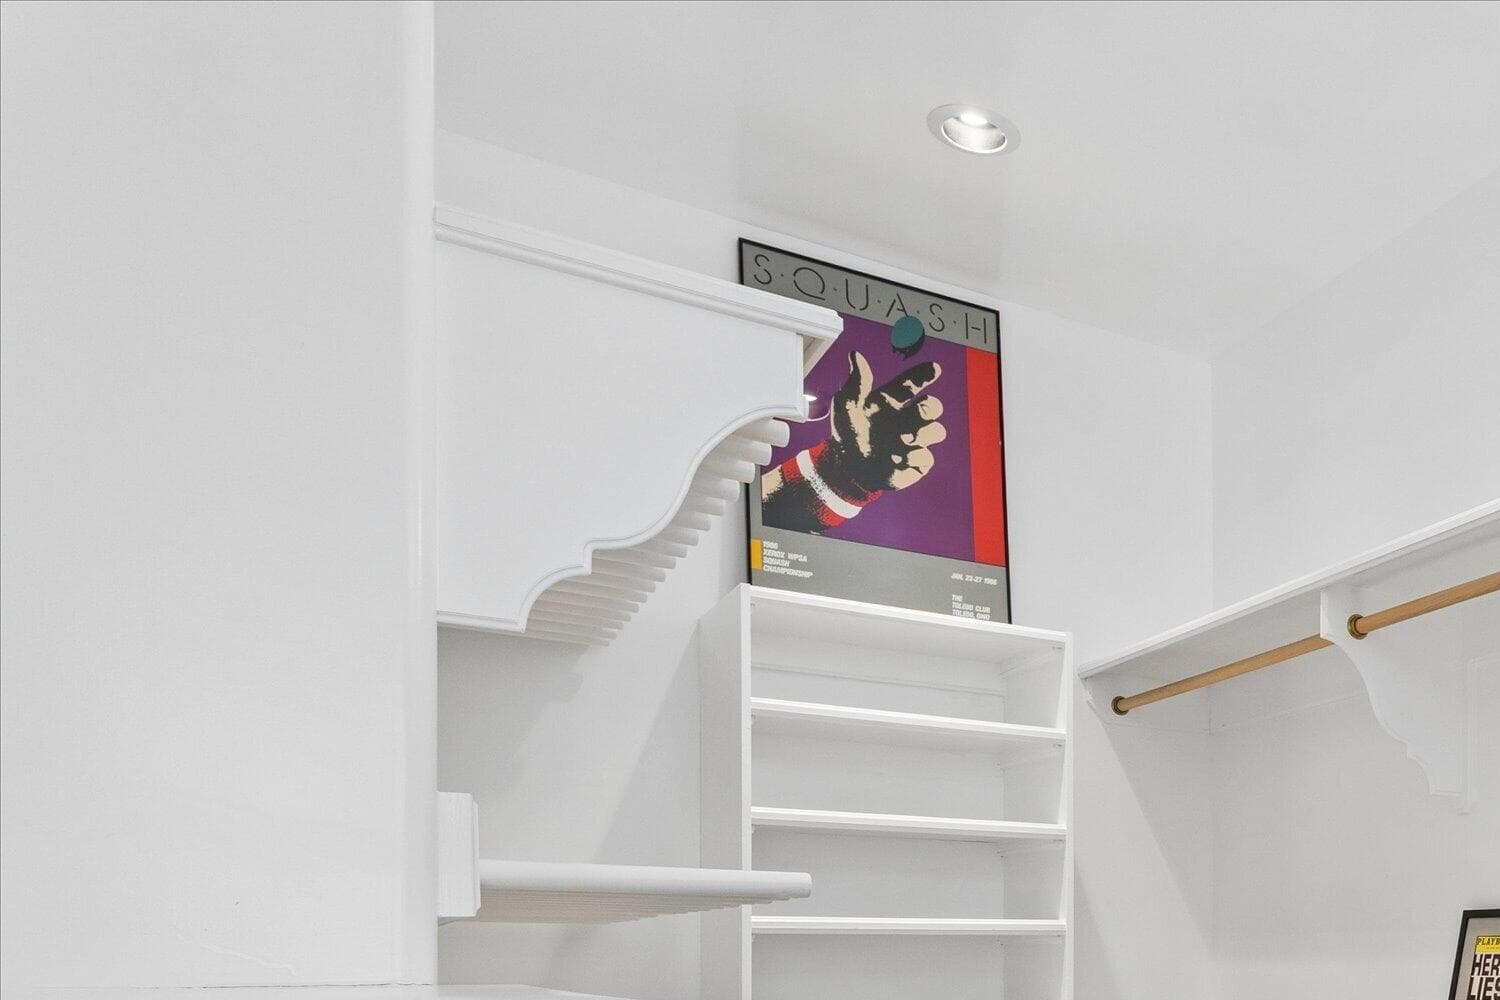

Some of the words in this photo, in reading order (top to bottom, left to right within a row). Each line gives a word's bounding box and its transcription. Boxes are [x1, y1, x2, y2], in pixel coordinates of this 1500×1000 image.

[763, 549, 786, 559] XEROX
[763, 556, 790, 567] SQUASH
[763, 565, 813, 578] CHAMPIONSHIP
[952, 602, 974, 611] TOLEDO
[975, 606, 990, 614] CLUB
